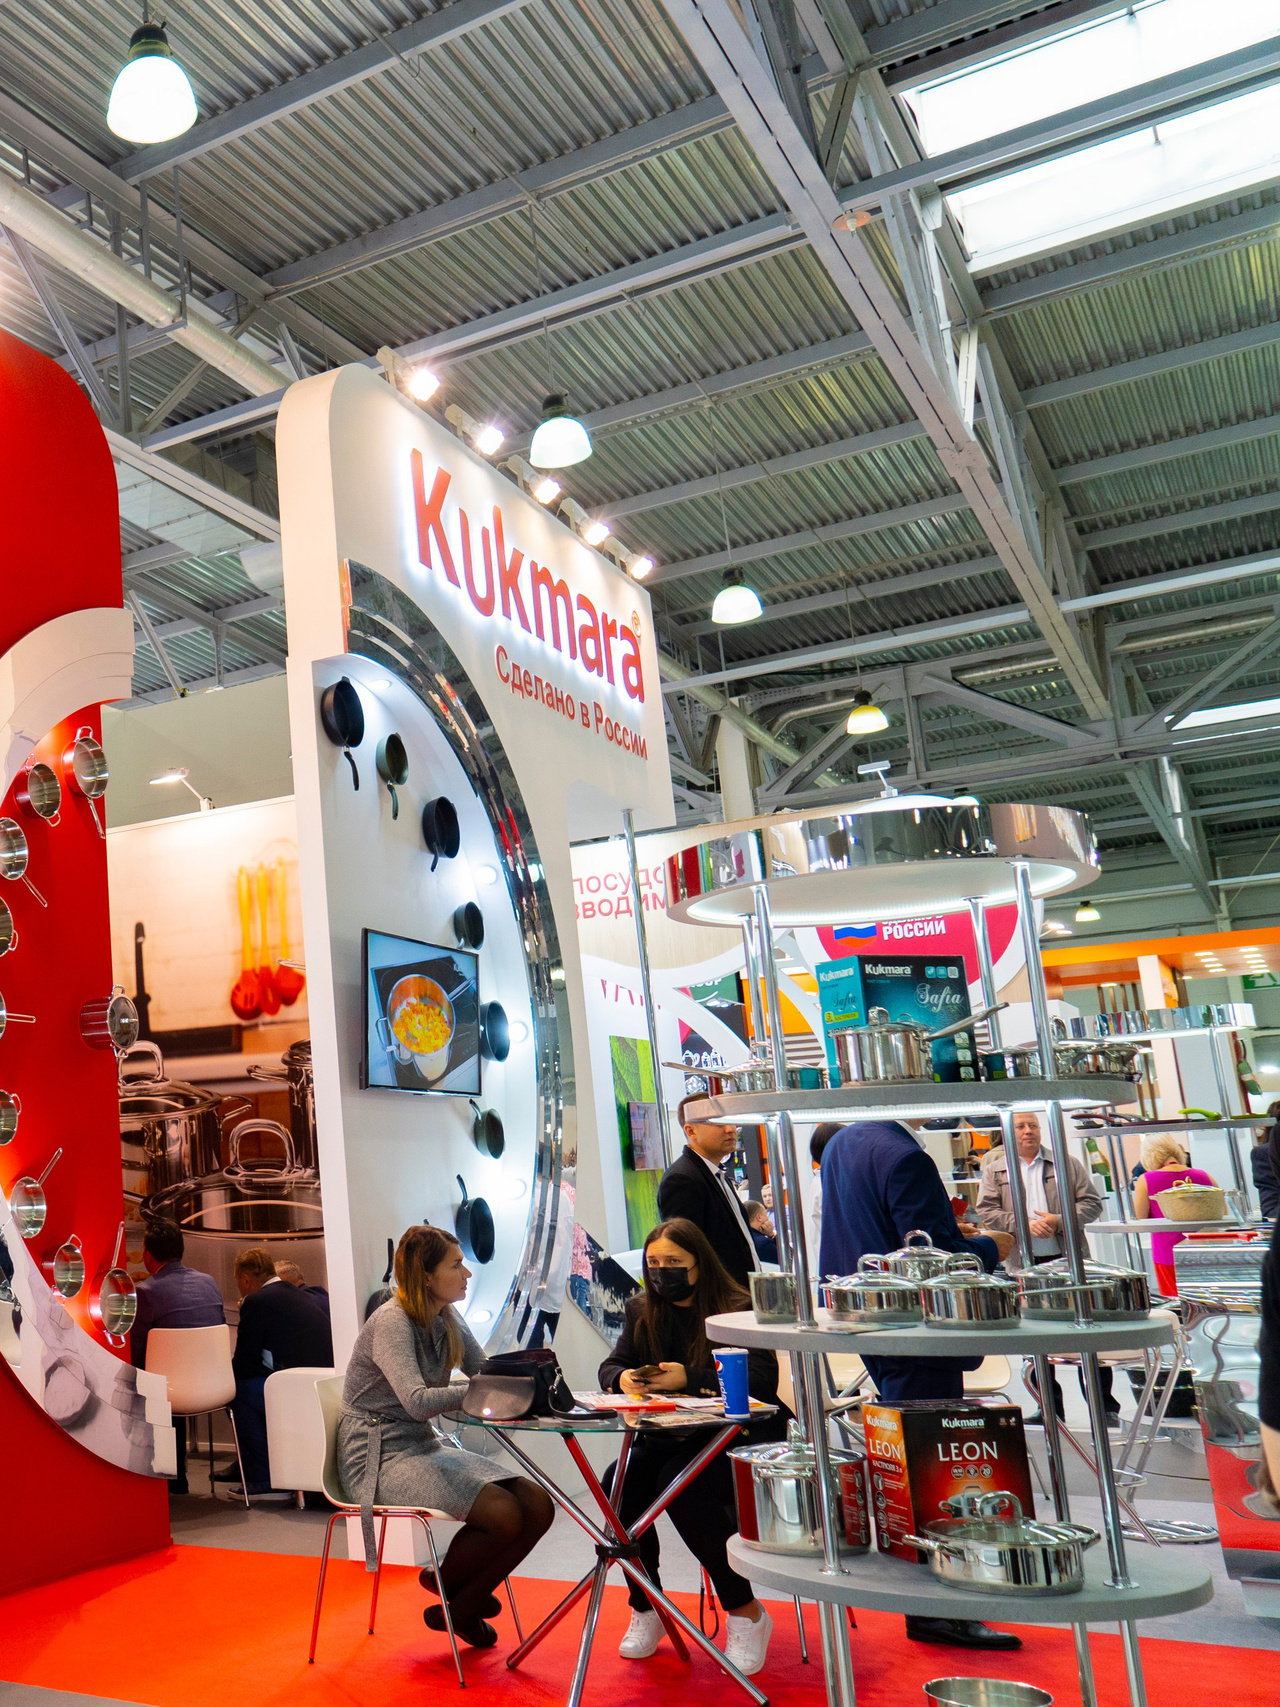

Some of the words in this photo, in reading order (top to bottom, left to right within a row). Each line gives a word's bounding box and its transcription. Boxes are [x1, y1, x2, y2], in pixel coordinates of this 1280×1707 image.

[494, 643, 577, 721] Сделано
[579, 699, 592, 730] в
[593, 699, 649, 763] России
[882, 919, 946, 941] РОССИИ
[819, 967, 854, 982] Kukmara
[866, 1414, 898, 1431] Kukmara
[869, 1438, 902, 1460] LEON
[937, 1441, 999, 1462] LEON
